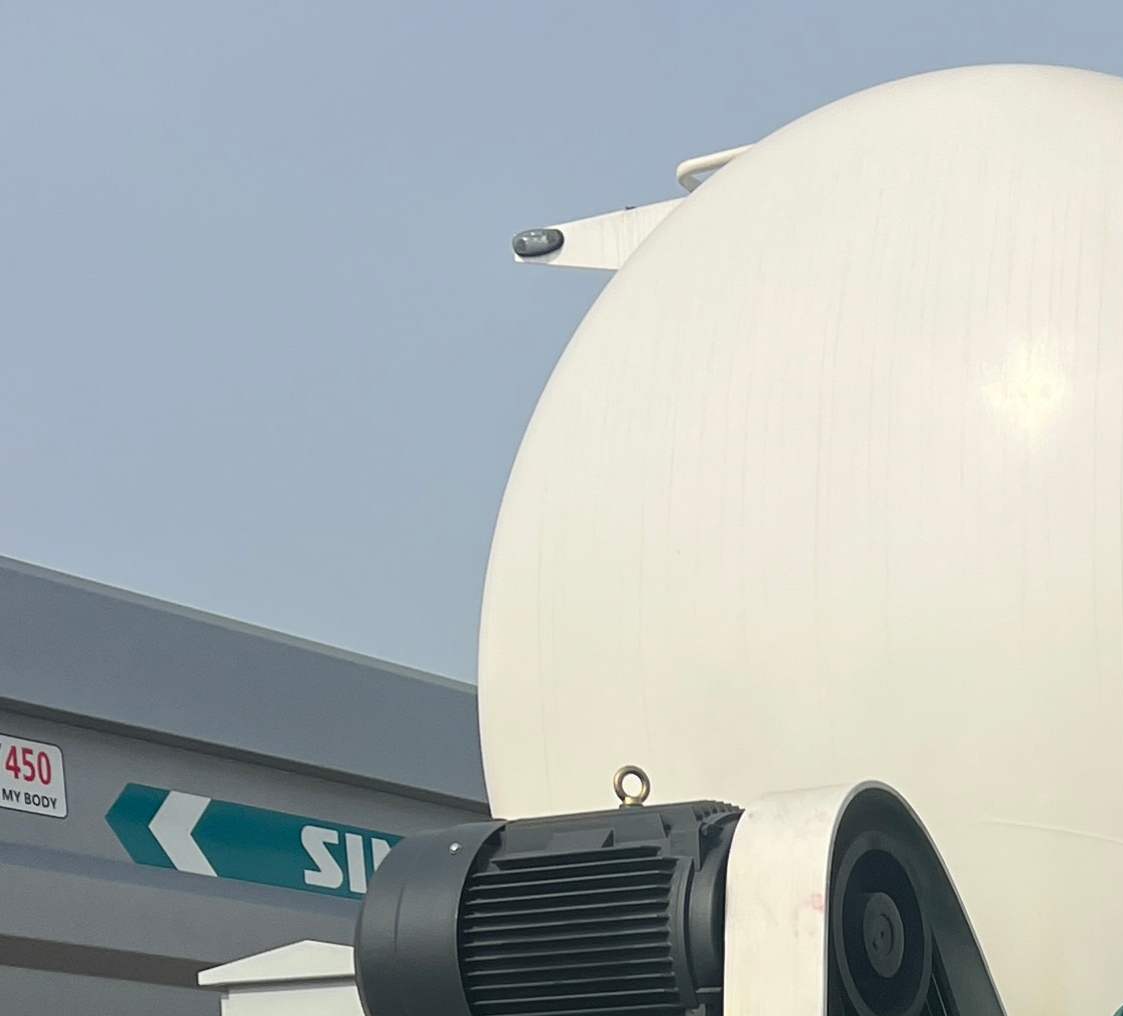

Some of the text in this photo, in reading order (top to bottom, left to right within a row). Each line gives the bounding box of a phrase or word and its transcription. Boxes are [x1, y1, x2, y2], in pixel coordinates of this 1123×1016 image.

[5, 745, 52, 785] 450
[2, 788, 57, 809] MY BODY
